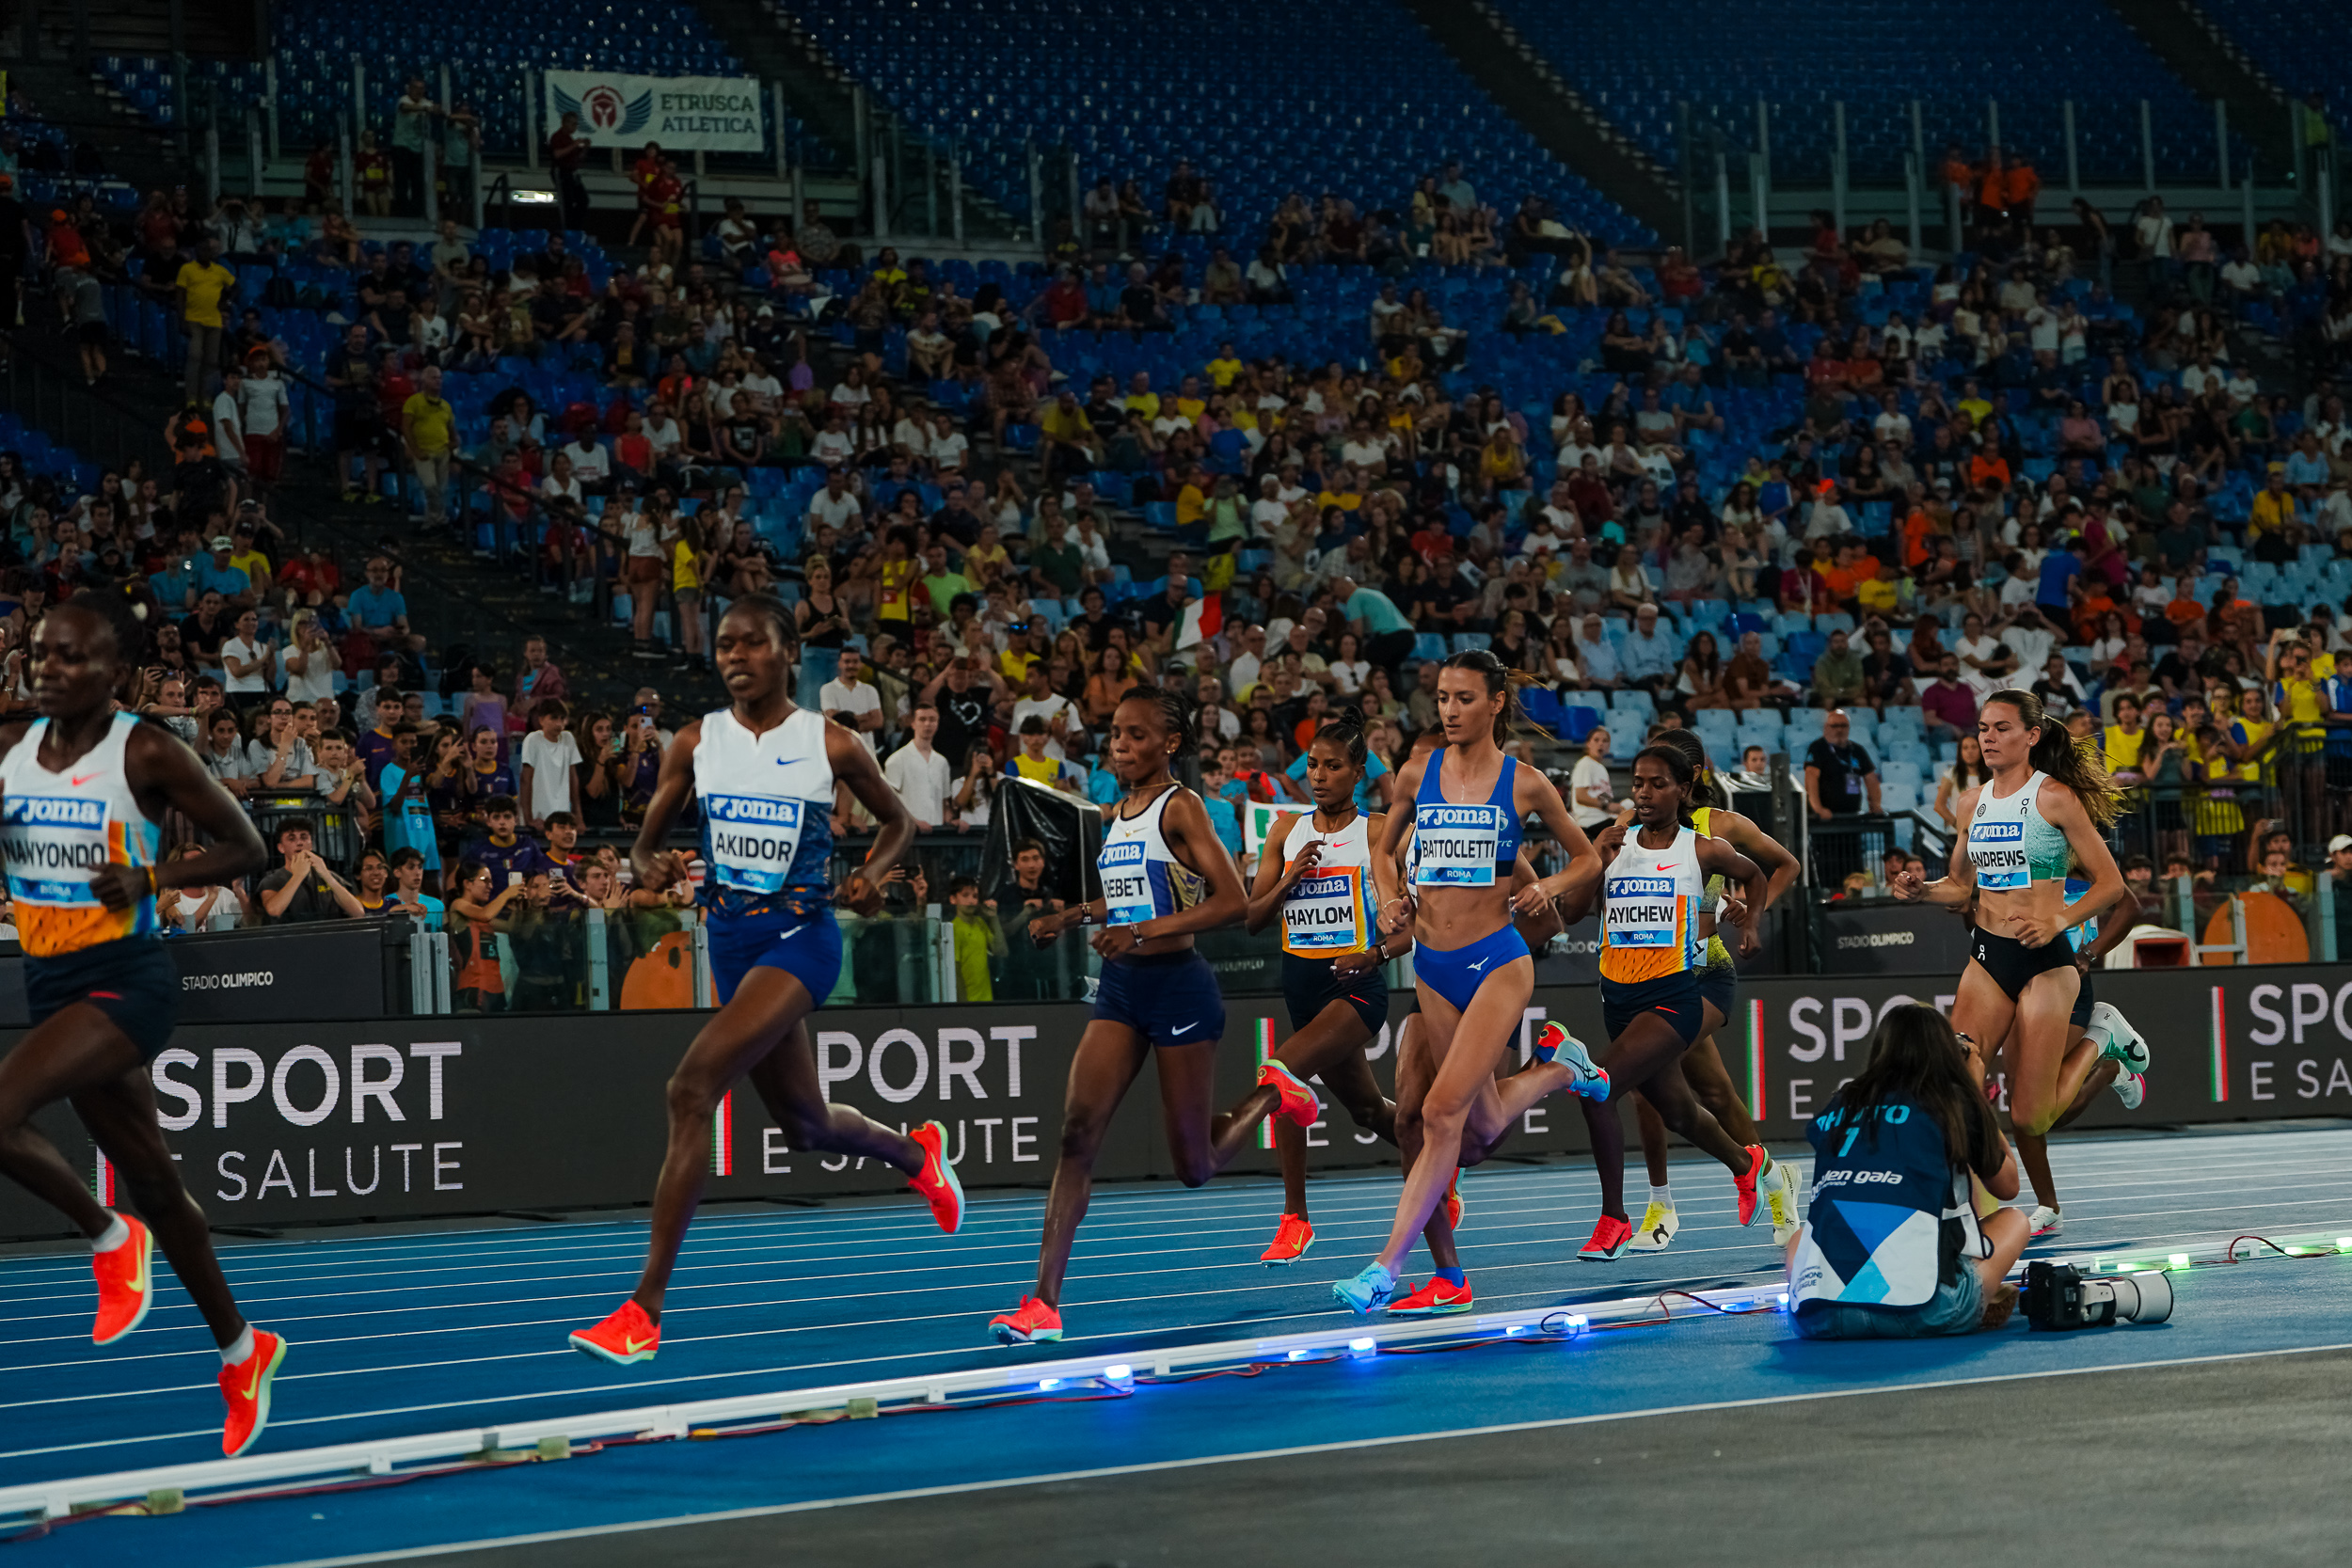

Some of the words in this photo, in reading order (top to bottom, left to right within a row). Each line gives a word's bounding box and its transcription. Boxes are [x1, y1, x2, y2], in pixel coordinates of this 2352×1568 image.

[661, 93, 755, 112] ETRUSCA
[661, 116, 756, 134] ATLETICA
[21, 799, 102, 825] Joma
[725, 798, 796, 823] Joma
[1433, 809, 1493, 826] Joma
[1979, 824, 2021, 840] Joma
[715, 832, 793, 862] AKIDOR
[1104, 845, 1142, 865] Joma
[1422, 839, 1496, 859] BATTOCLETTI
[1971, 849, 2026, 867] ANDREWS
[1446, 869, 1472, 879] ROMA
[1298, 879, 1347, 897] Joma
[1620, 879, 1673, 895] Joma
[1285, 905, 1354, 927] HAYLOM
[1607, 905, 1675, 925] AYICHEW
[1870, 931, 1915, 947] OLIMPICO
[182, 974, 220, 991] STADIO
[221, 971, 274, 989] OLIMPICO
[817, 1025, 1037, 1103] PORT
[151, 1041, 462, 1132] SPORT
[2251, 1061, 2276, 1101] E
[1789, 1079, 1815, 1119] E
[763, 1128, 791, 1174] E
[1837, 1127, 1860, 1158] 1
[216, 1141, 464, 1202] SALUTE
[1853, 1170, 1903, 1185] gala
